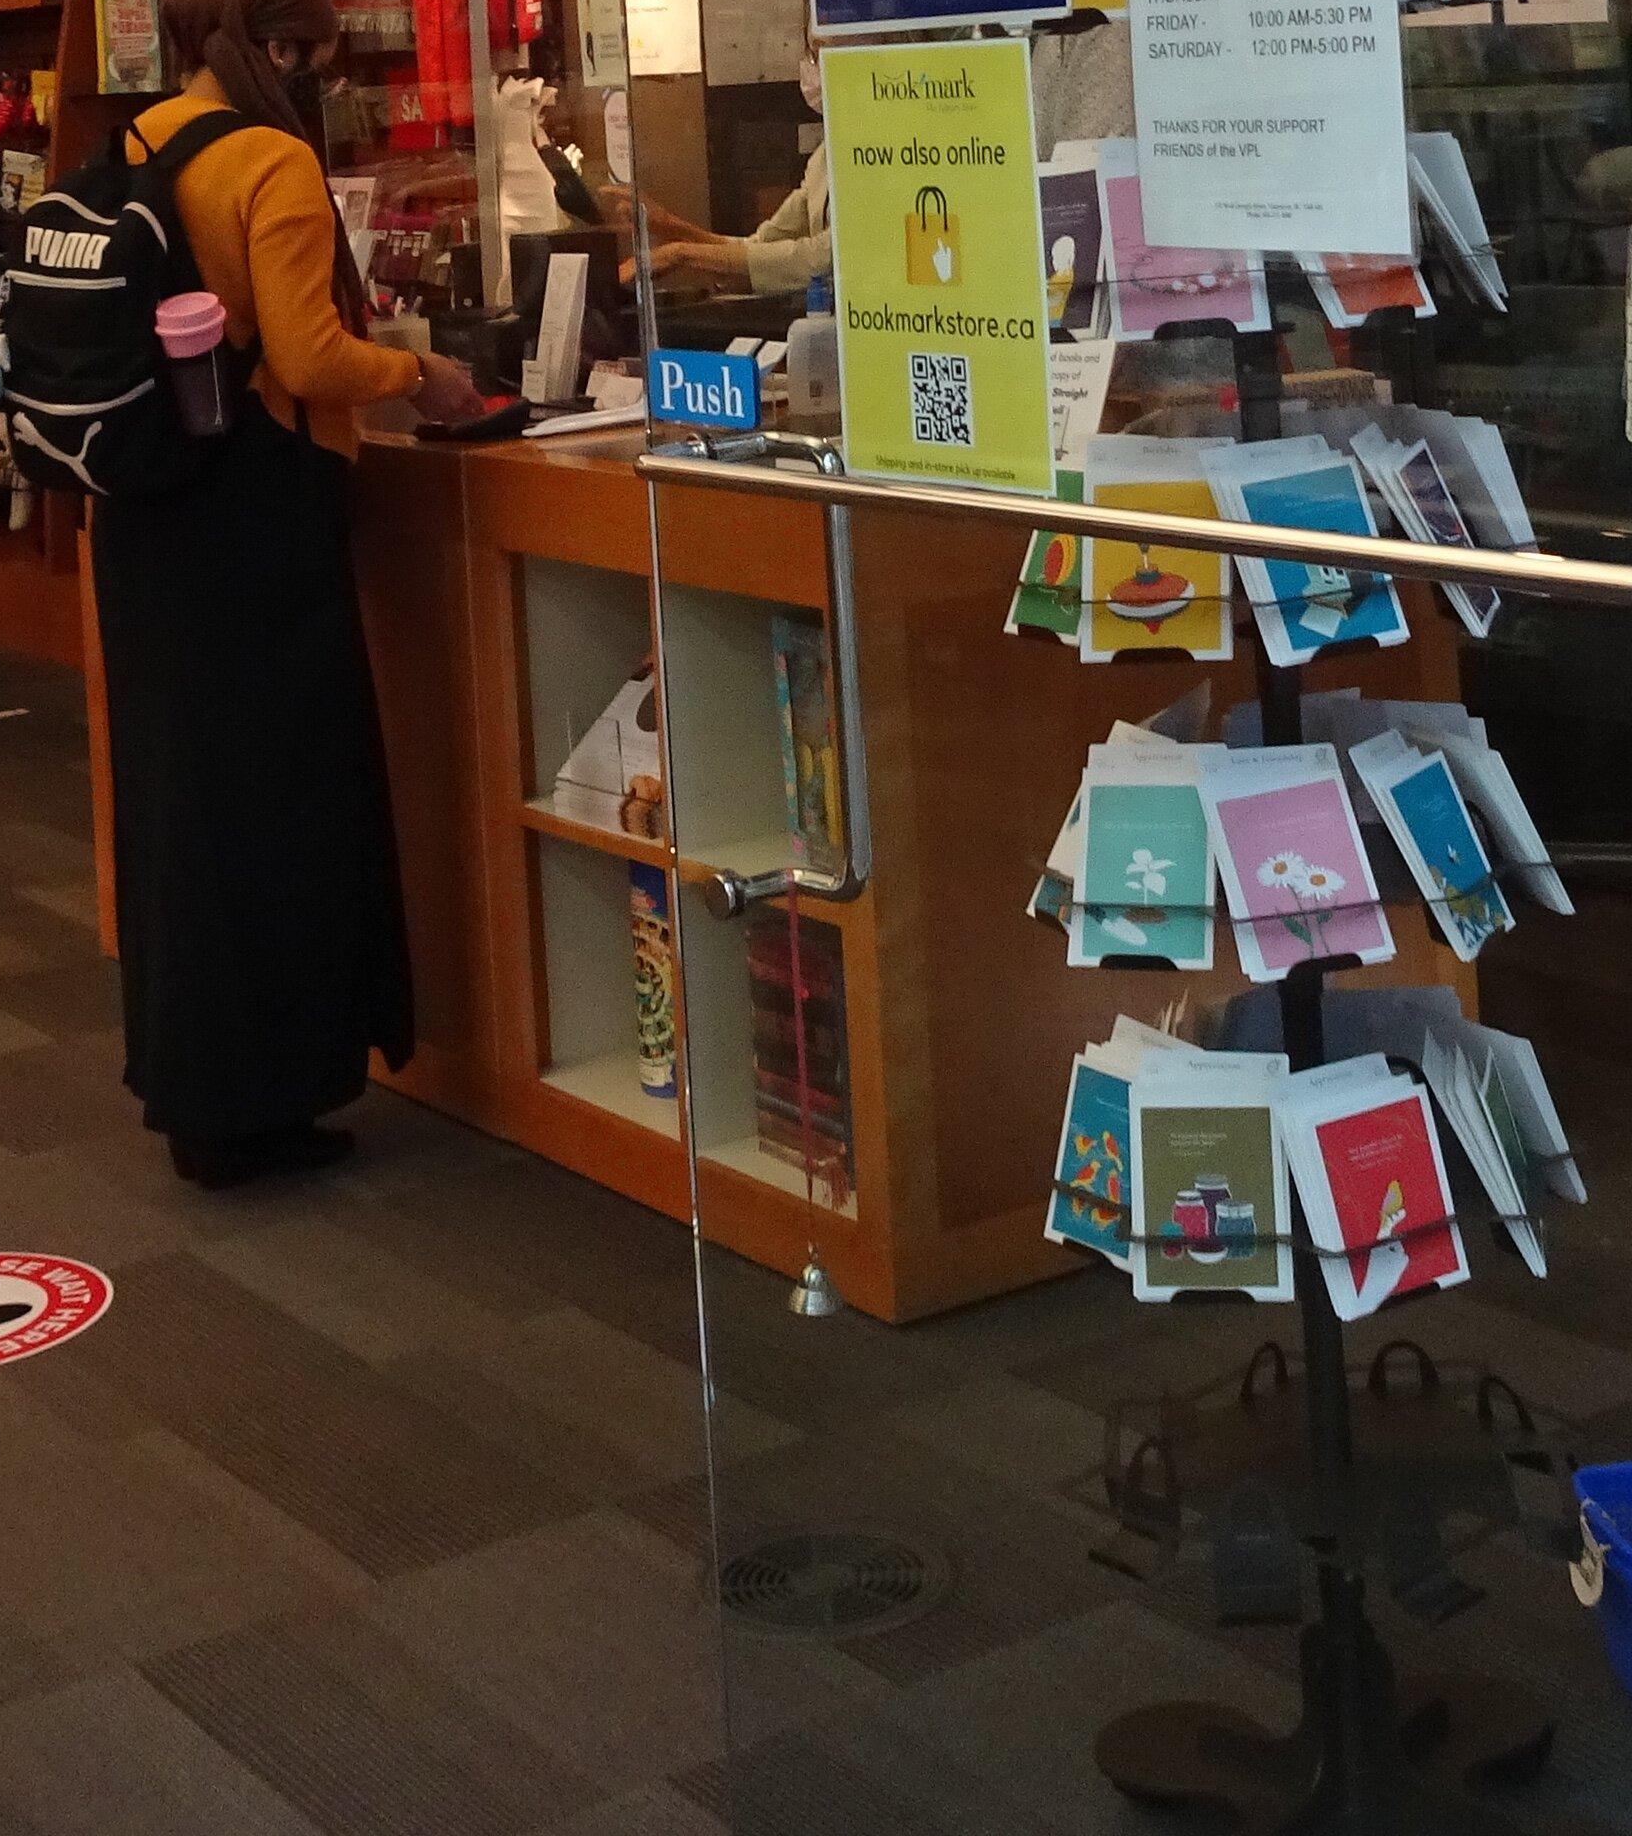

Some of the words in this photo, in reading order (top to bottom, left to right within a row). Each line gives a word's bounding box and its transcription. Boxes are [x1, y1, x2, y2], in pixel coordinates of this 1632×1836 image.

[1147, 14, 1198, 31] FRIDAY
[1248, 11, 1283, 28] 10:00
[1287, 8, 1344, 26] AM-5:30
[1349, 6, 1372, 23] PM
[1149, 41, 1222, 59] SATURDAY
[1252, 39, 1287, 56] 12:00
[1291, 36, 1348, 54] PM-5:00
[1352, 35, 1376, 53] PM
[1153, 120, 1199, 134] THANKS
[1202, 120, 1227, 134] FOR
[1229, 119, 1263, 134] YOUR
[1266, 118, 1325, 134] SUPPORT
[853, 147, 893, 166] now
[900, 137, 941, 166] also
[947, 136, 1005, 165] online
[1153, 143, 1204, 157] FRIENDS
[1207, 143, 1217, 157] of
[1219, 145, 1236, 157] the
[1238, 143, 1261, 158] VPL
[25, 226, 111, 270] PUMA
[848, 302, 1035, 341] bookmarkstore.ca
[660, 360, 745, 419] Push
[42, 1266, 92, 1305] WAIT
